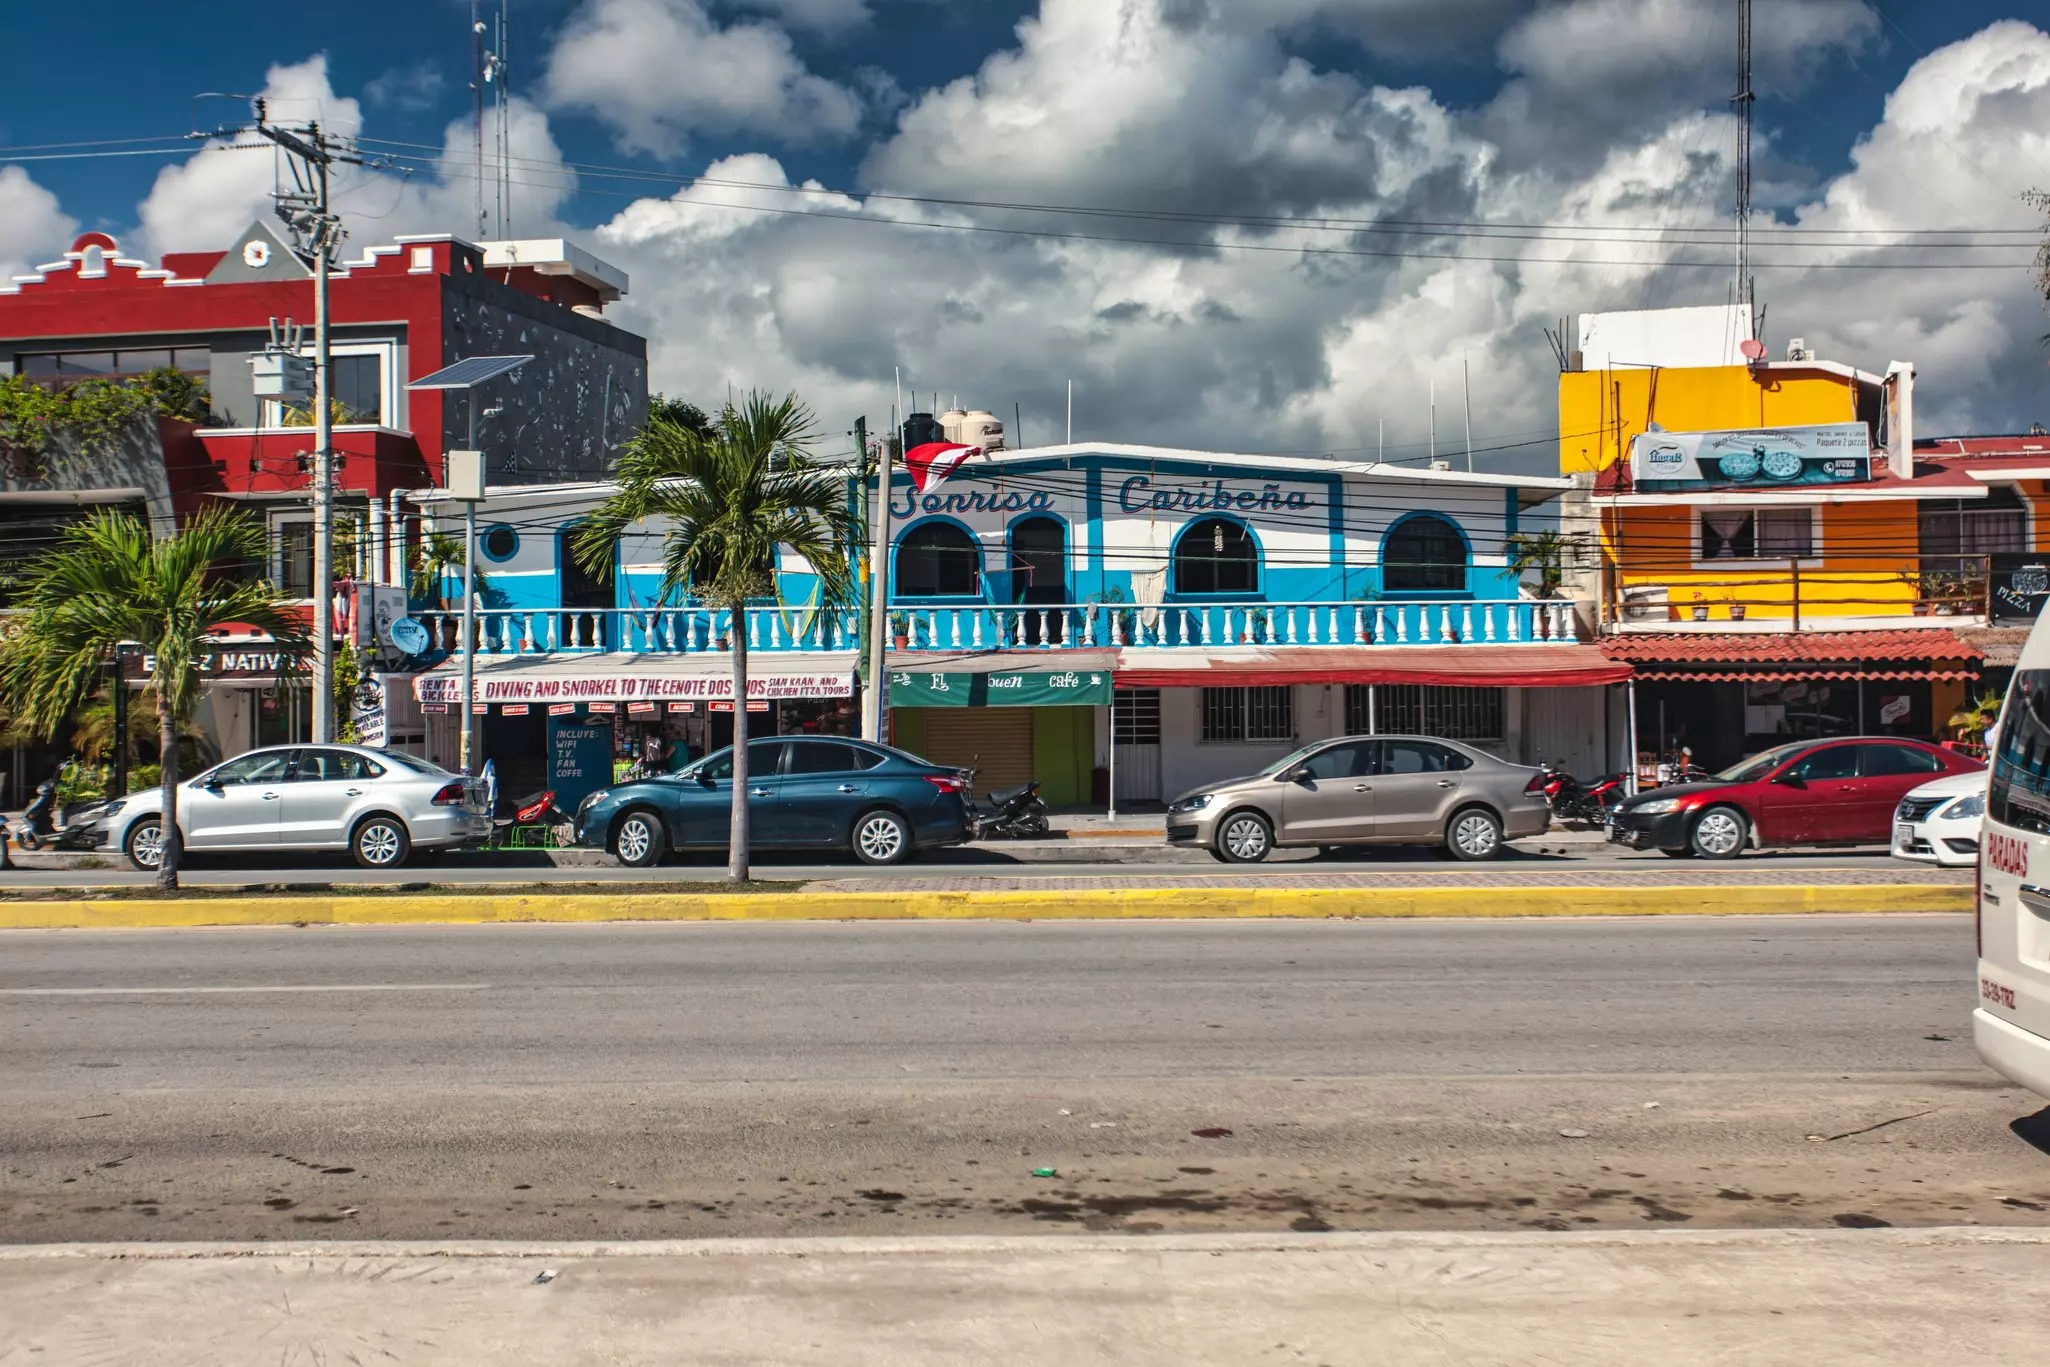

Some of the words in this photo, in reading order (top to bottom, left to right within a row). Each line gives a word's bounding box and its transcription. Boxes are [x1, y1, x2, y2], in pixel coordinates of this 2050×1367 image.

[1816, 438, 1842, 447] Paquete
[1842, 438, 1847, 447] 2
[889, 484, 1055, 519] Sonrisa
[1119, 475, 1315, 514] Caribeña
[1997, 585, 2031, 612] PIZZA
[420, 680, 456, 690] RENTA
[768, 677, 788, 687] SIAN
[789, 677, 814, 687] KAAN
[819, 677, 838, 686] AND
[930, 673, 949, 691] El
[988, 673, 1022, 688] buen
[1049, 671, 1079, 688] café
[485, 681, 533, 699] DIVING
[534, 681, 560, 697] AND
[561, 680, 617, 697] SNORKEL
[621, 679, 636, 695] TO
[662, 679, 706, 695] CENOTE
[708, 679, 733, 696] DOS
[766, 687, 798, 697] CHICHEN
[823, 686, 850, 695] TOURS
[556, 730, 599, 739] INCLUYE:
[556, 740, 577, 749] WIFI
[557, 750, 574, 758] T.V.
[556, 760, 576, 768] FAN
[556, 770, 582, 778] COFFE
[1987, 832, 2028, 879] PARADAS
